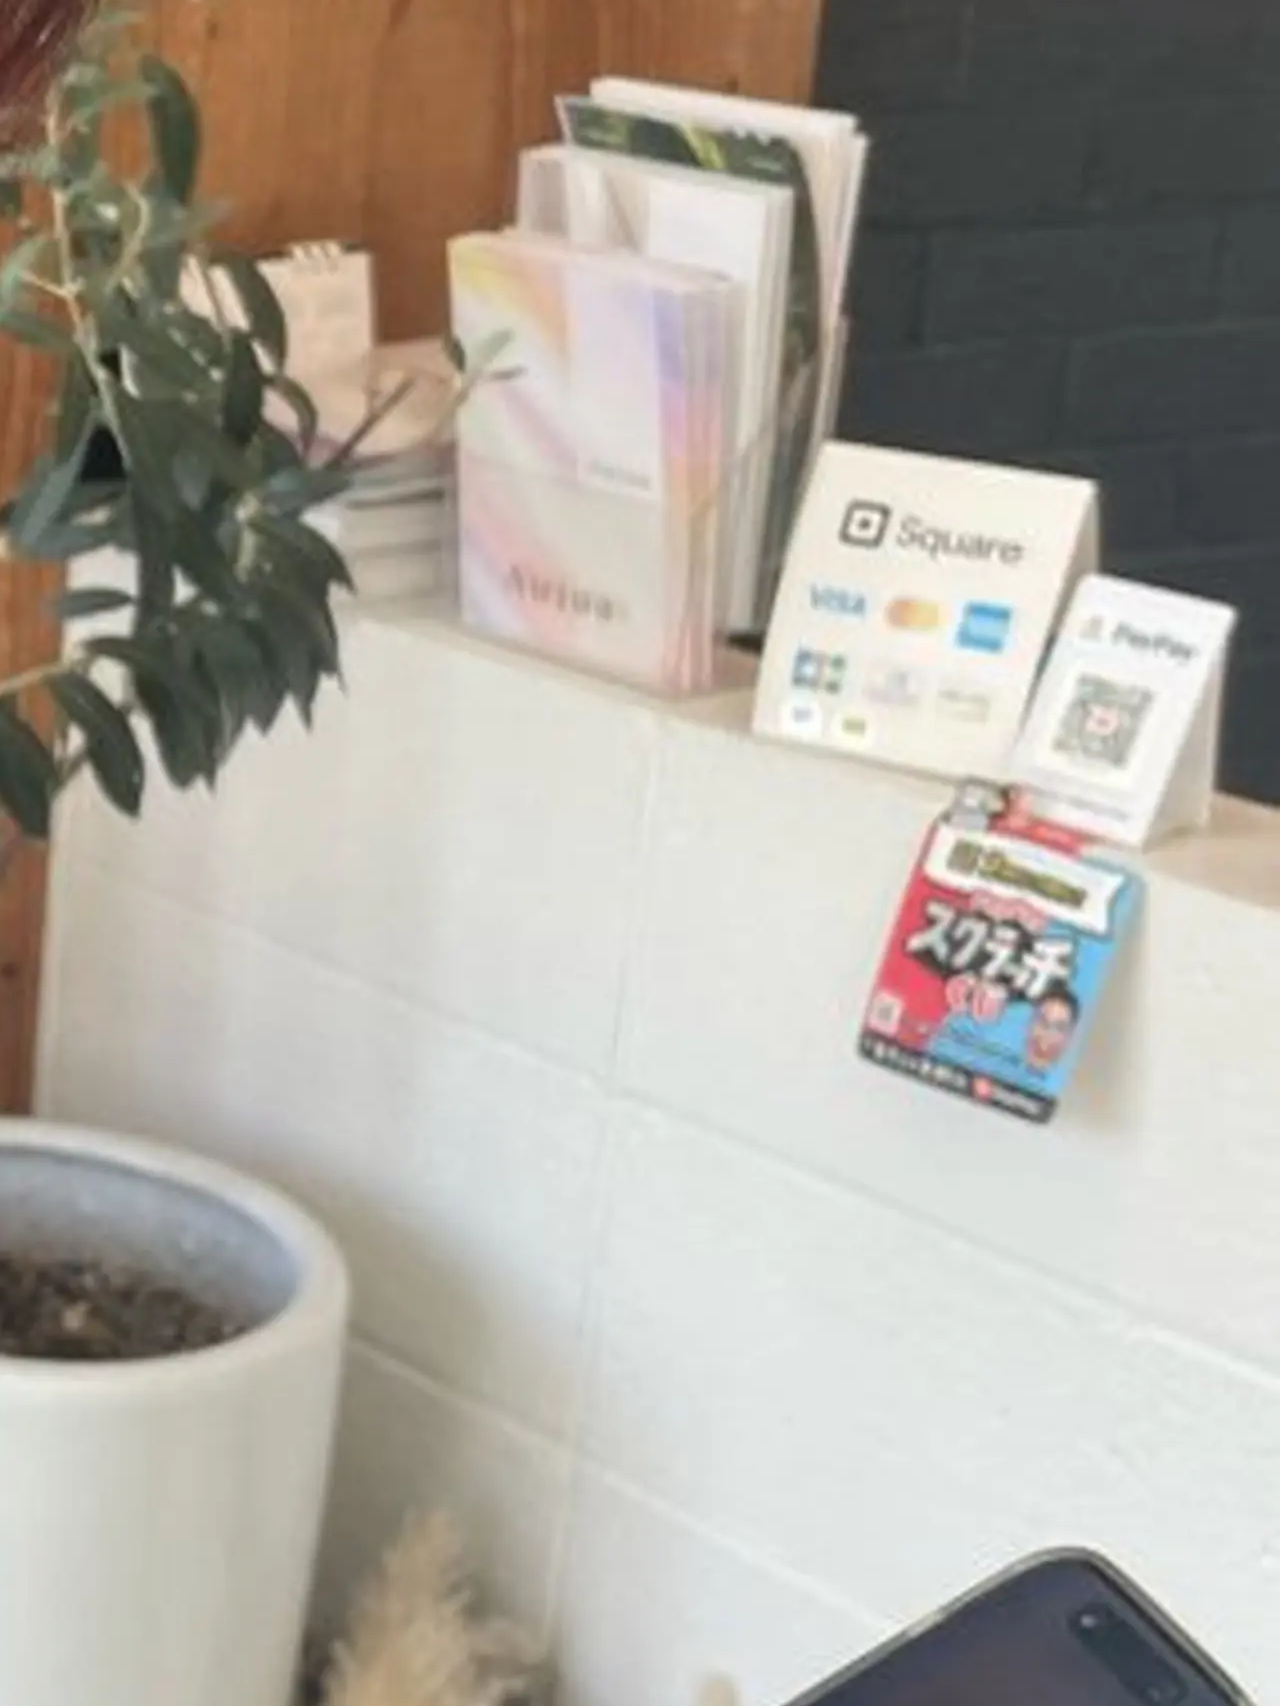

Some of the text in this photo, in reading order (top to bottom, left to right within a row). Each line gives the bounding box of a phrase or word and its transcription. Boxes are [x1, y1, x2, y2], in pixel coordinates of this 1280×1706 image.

[895, 515, 1027, 566] Square
[810, 584, 867, 616] VISA
[904, 898, 1074, 999] スクラッチ
